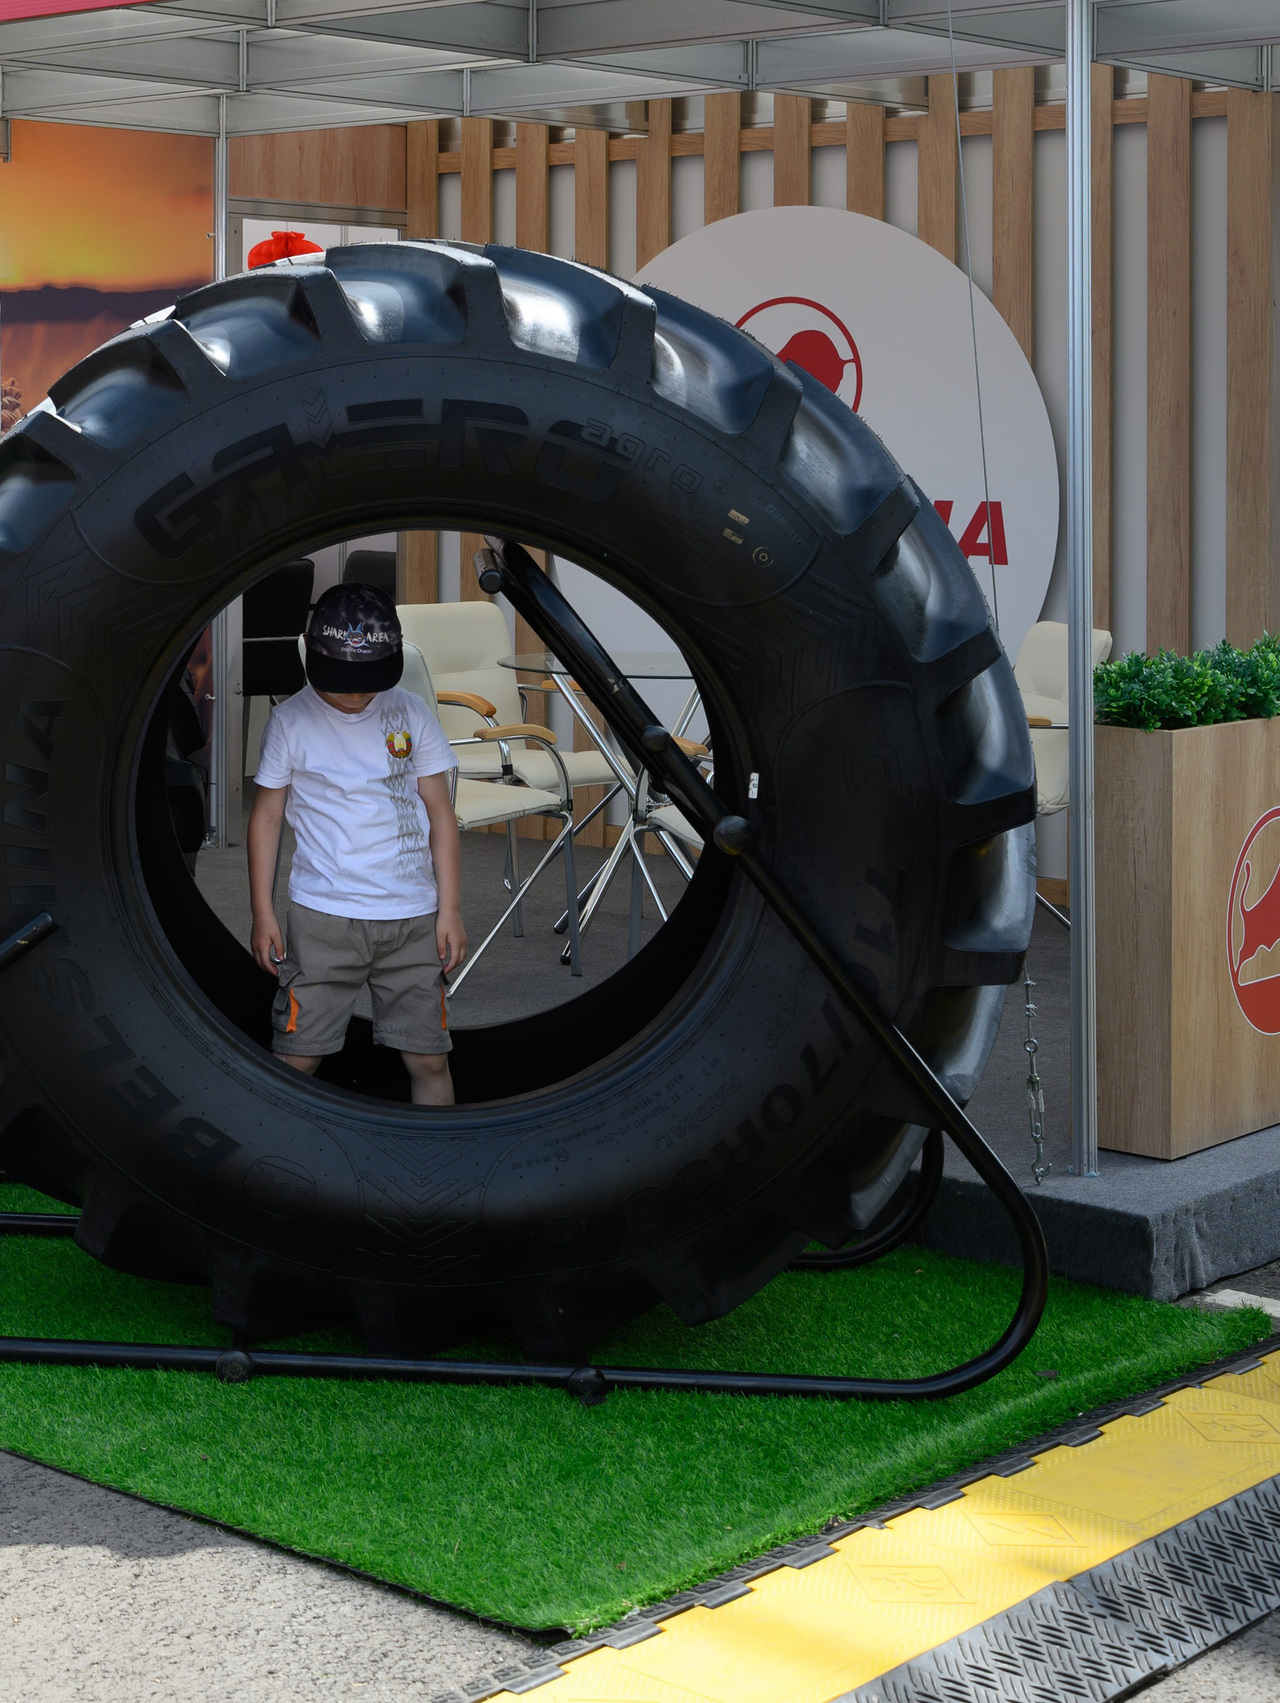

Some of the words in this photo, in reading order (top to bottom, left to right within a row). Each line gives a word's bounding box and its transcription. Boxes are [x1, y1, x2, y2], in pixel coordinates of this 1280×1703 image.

[580, 417, 707, 494] agro
[366, 631, 389, 643] AREA
[2, 698, 245, 1176] BELSHINA
[654, 1089, 664, 1099] IN
[666, 1073, 685, 1092] MADE
[620, 1096, 653, 1120] BELARUS
[654, 1073, 744, 1147] RADIAL
